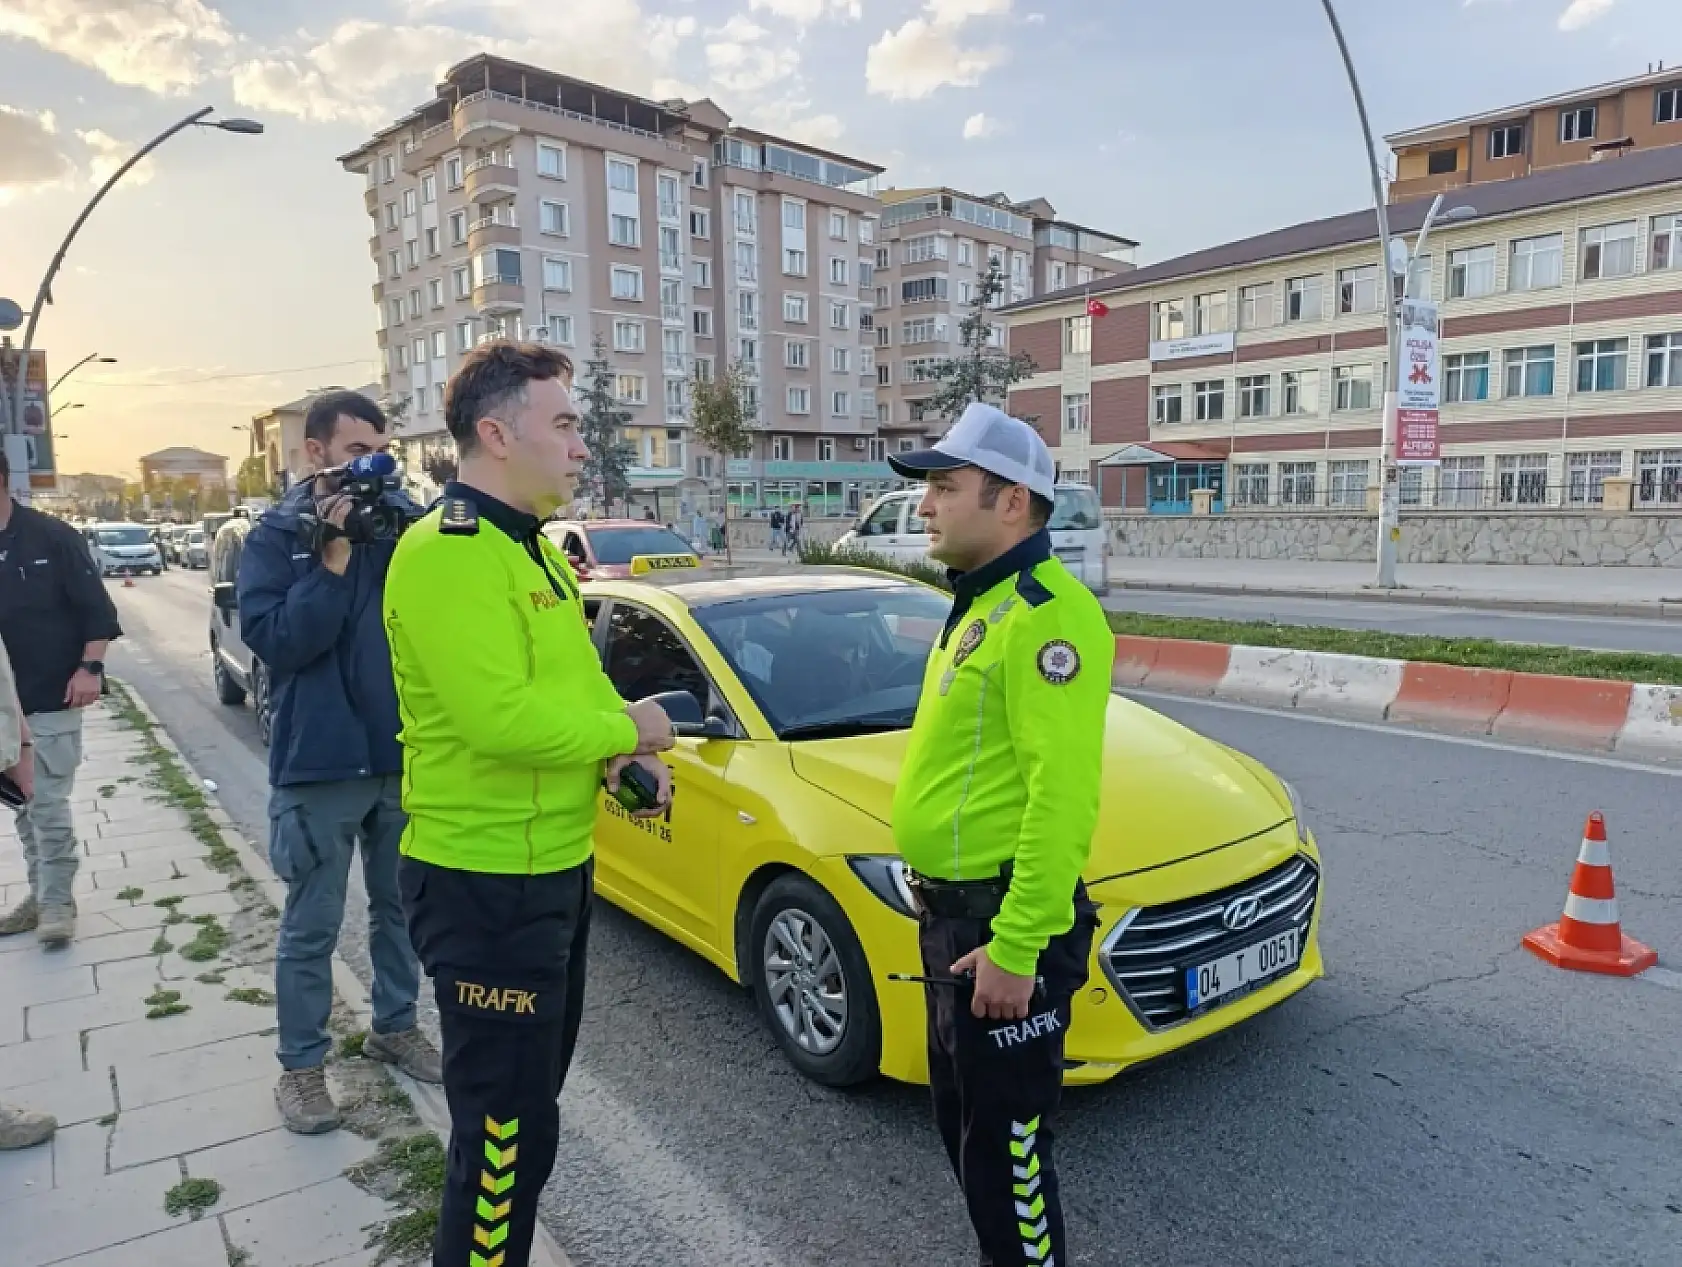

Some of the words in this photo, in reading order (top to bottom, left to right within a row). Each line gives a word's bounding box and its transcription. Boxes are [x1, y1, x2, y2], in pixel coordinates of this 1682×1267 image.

[1201, 963, 1221, 998] 04
[1236, 952, 1245, 982] T
[1259, 932, 1295, 973] 0051
